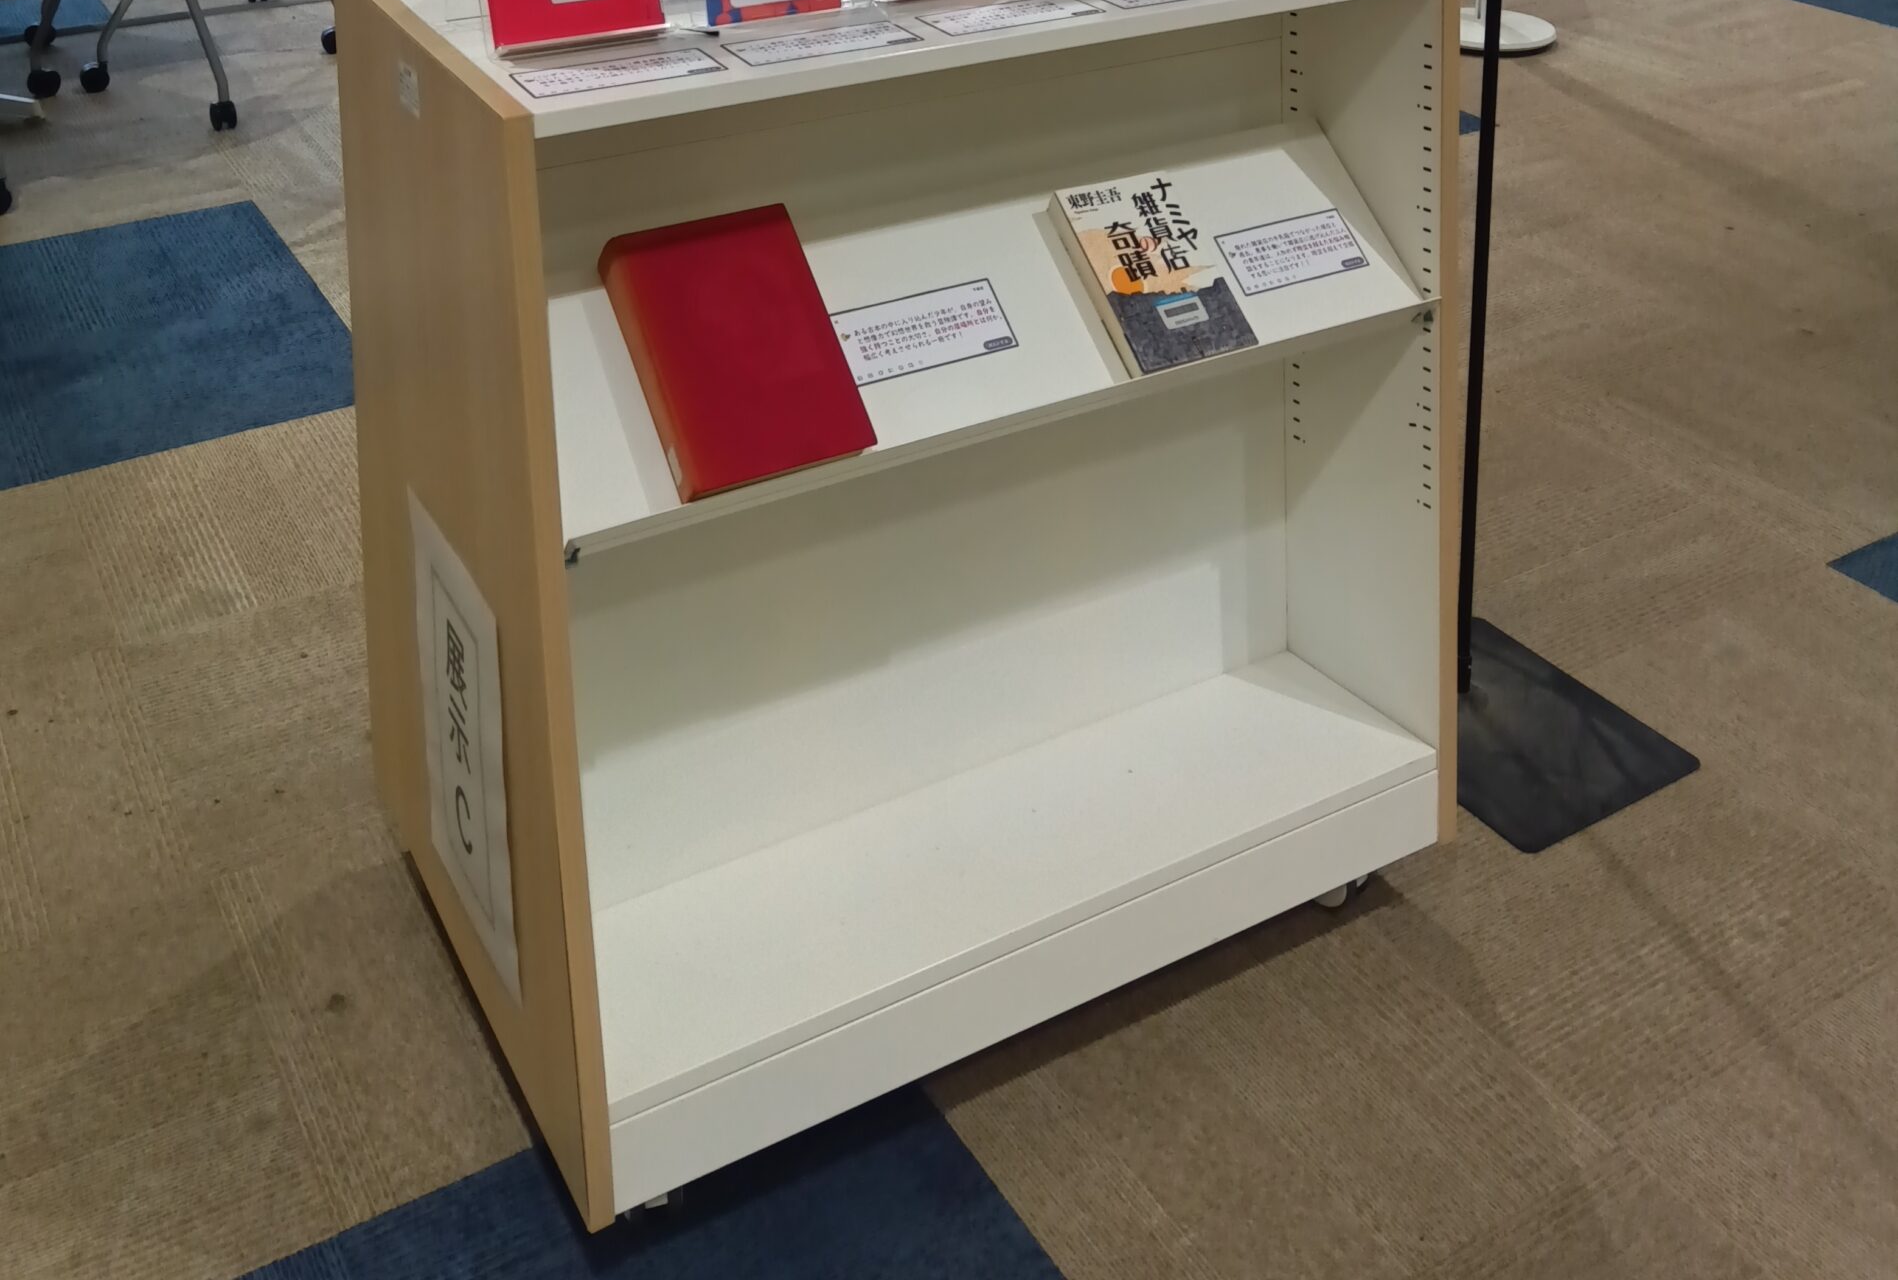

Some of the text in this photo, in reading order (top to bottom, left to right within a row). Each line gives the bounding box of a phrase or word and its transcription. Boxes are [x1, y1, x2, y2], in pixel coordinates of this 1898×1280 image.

[1065, 186, 1123, 210] 東野圭吾
[1150, 177, 1199, 251] ナミヤ
[1104, 220, 1159, 283] 奇蹟
[1130, 191, 1191, 274] 雑貨店
